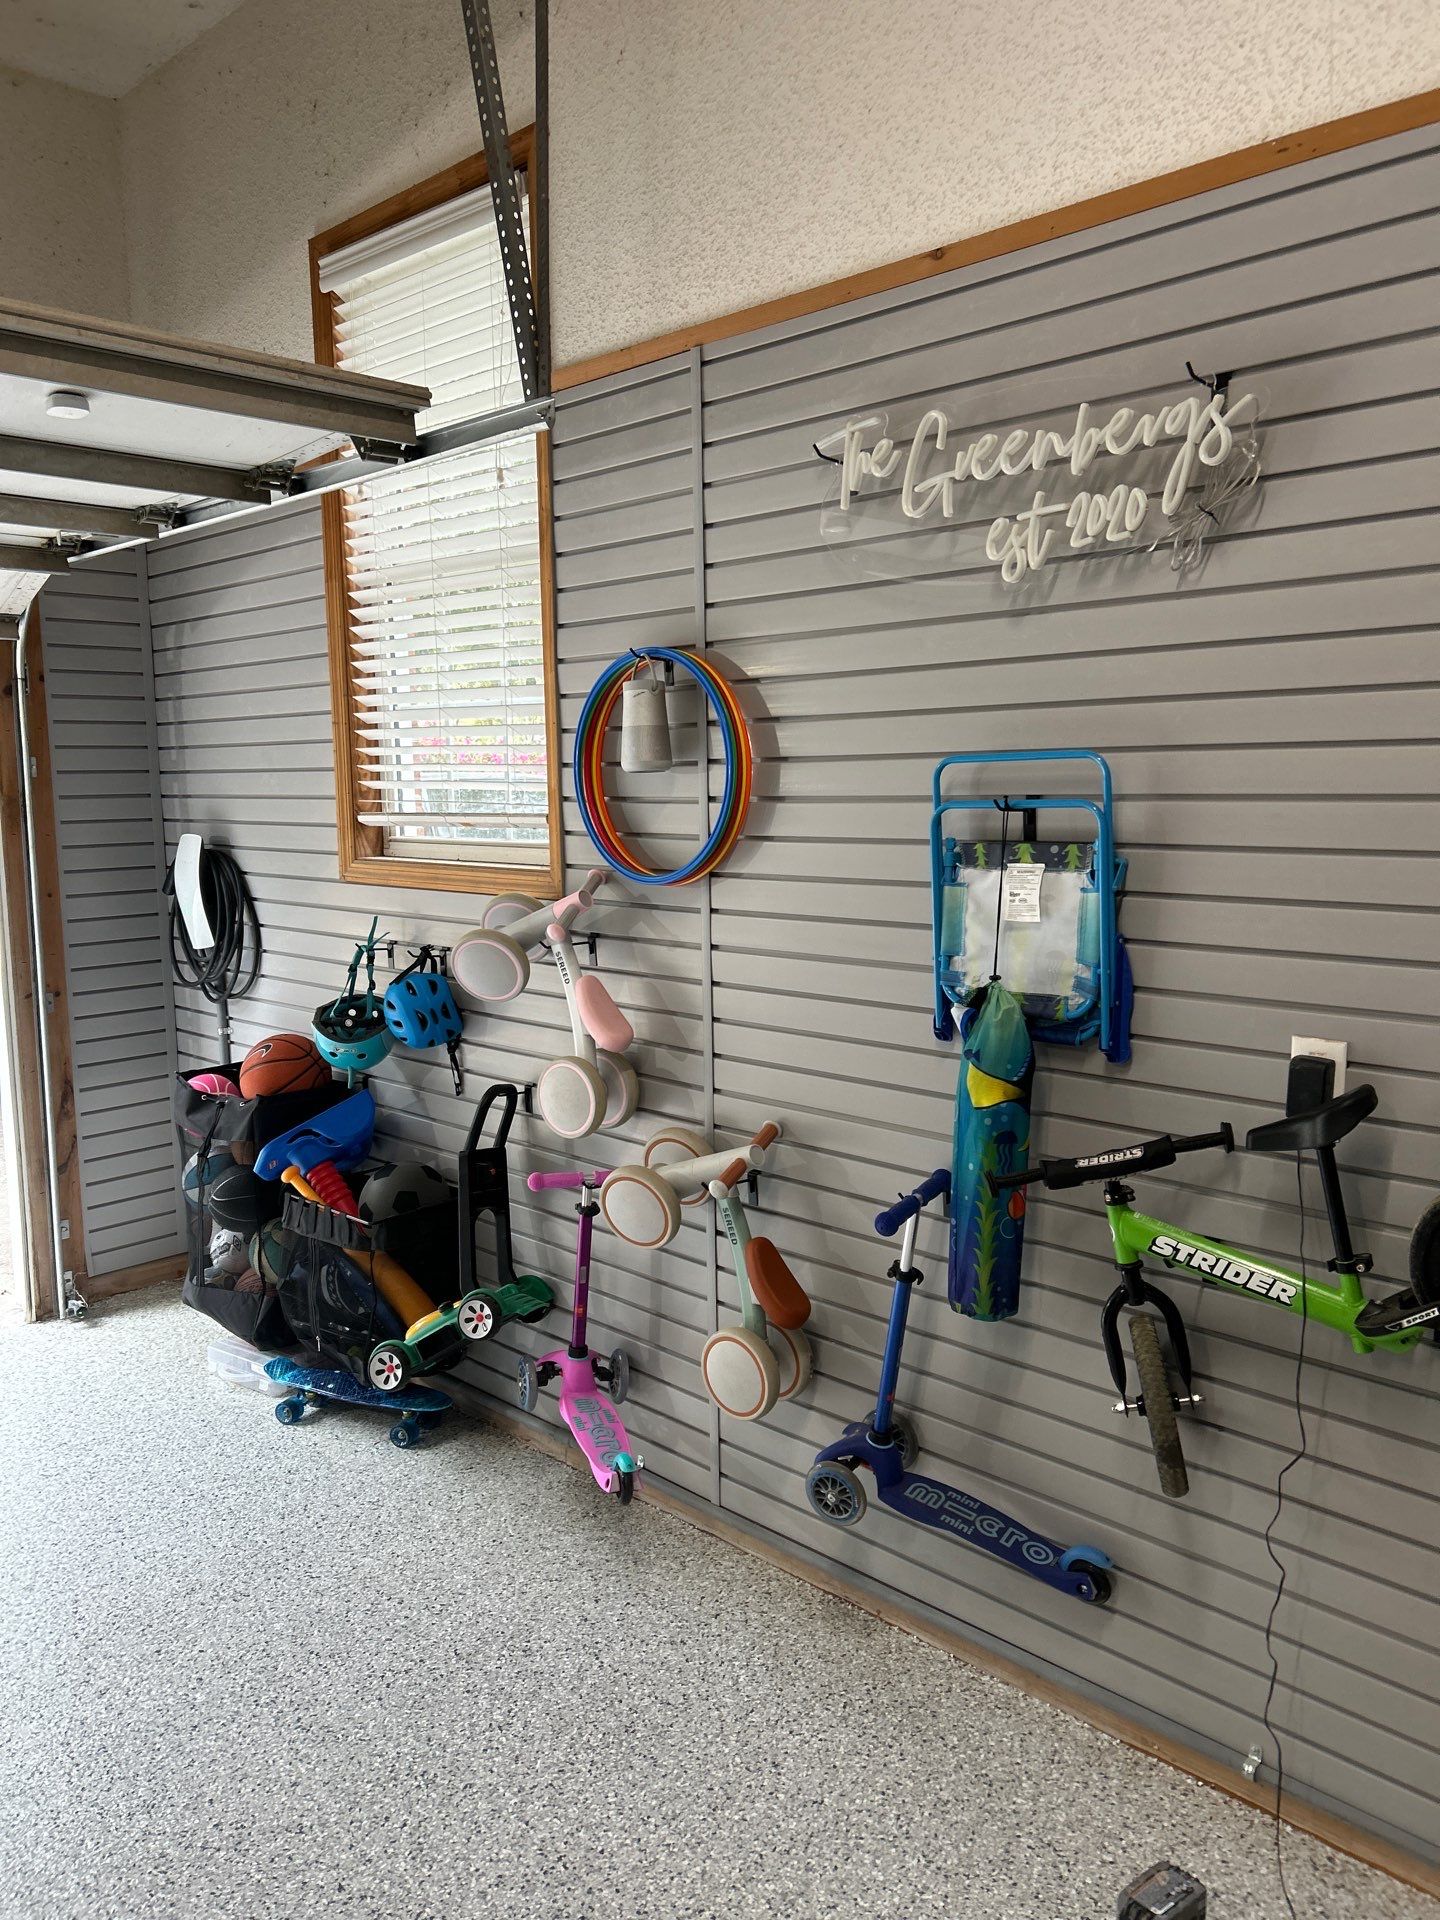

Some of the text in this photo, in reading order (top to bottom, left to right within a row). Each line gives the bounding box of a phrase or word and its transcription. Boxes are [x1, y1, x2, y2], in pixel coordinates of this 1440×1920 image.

[814, 393, 1257, 518] The Greenbergs
[986, 484, 1148, 584] est 2020
[555, 951, 571, 985] SEREED
[1075, 1148, 1144, 1168] STRIDER
[722, 1207, 738, 1245] SEREED
[1150, 1235, 1298, 1304] STRIDER
[1405, 1309, 1436, 1325] SPORT
[947, 1491, 981, 1509] mini
[904, 1482, 1054, 1565] micro
[940, 1514, 976, 1535] mini
